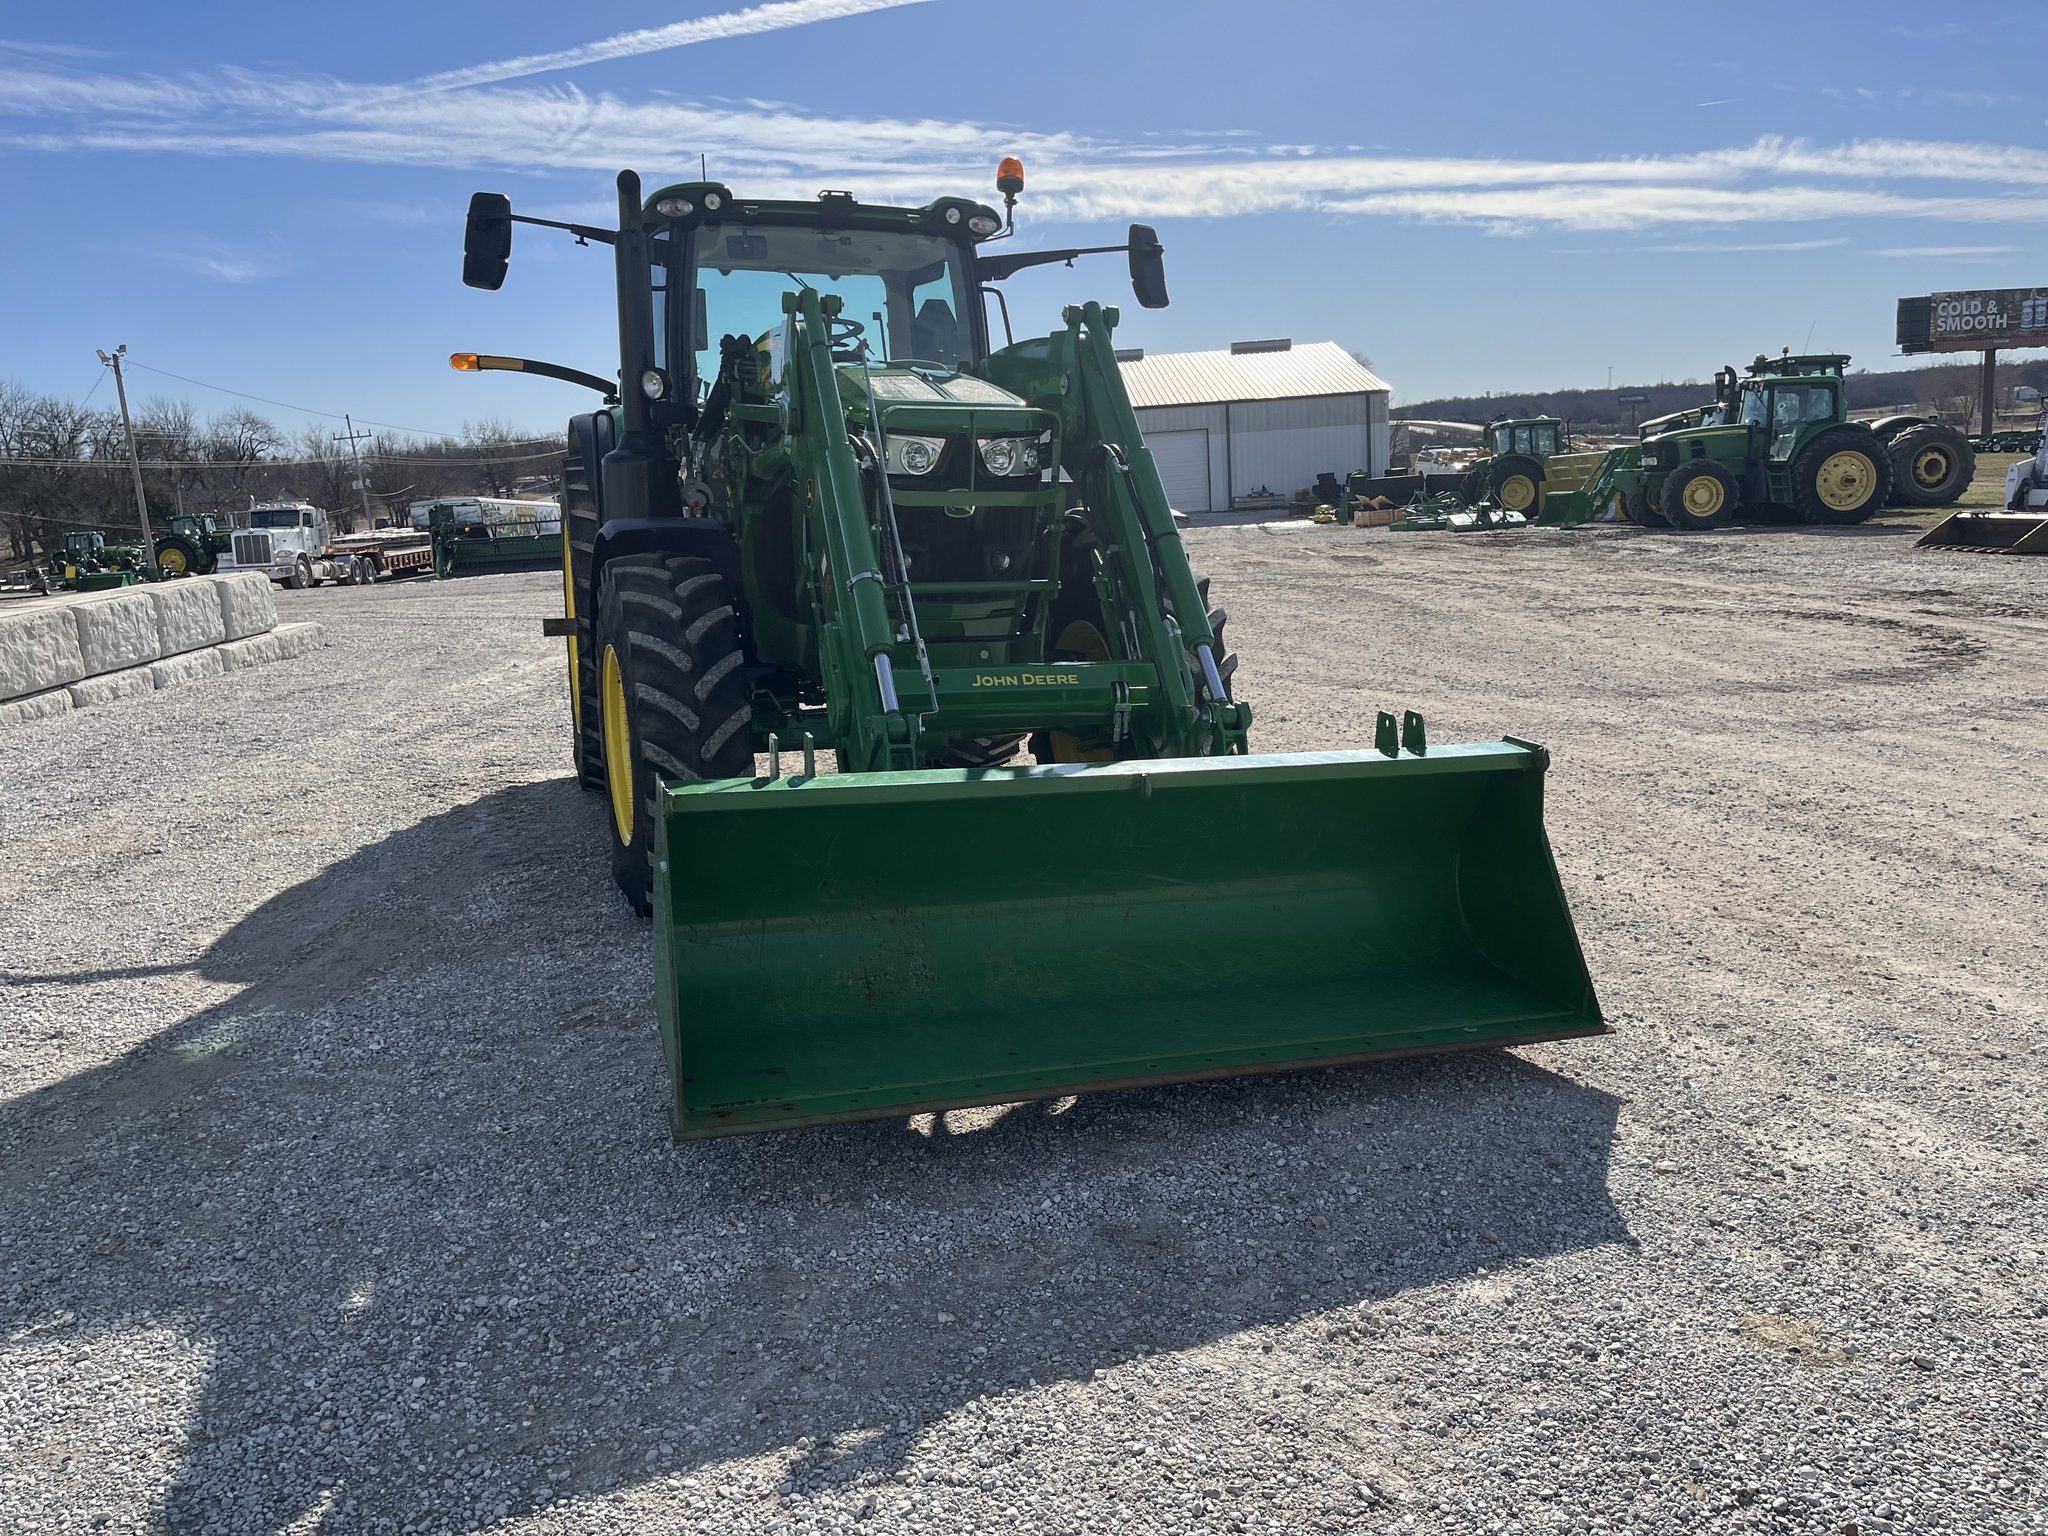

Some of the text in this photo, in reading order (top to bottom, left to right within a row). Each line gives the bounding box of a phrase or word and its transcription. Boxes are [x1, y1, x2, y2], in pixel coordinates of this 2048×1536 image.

[1937, 300, 1998, 317] COLD &
[1937, 314, 2008, 332] SMOOTH
[972, 673, 1079, 687] JOHN DEERE
